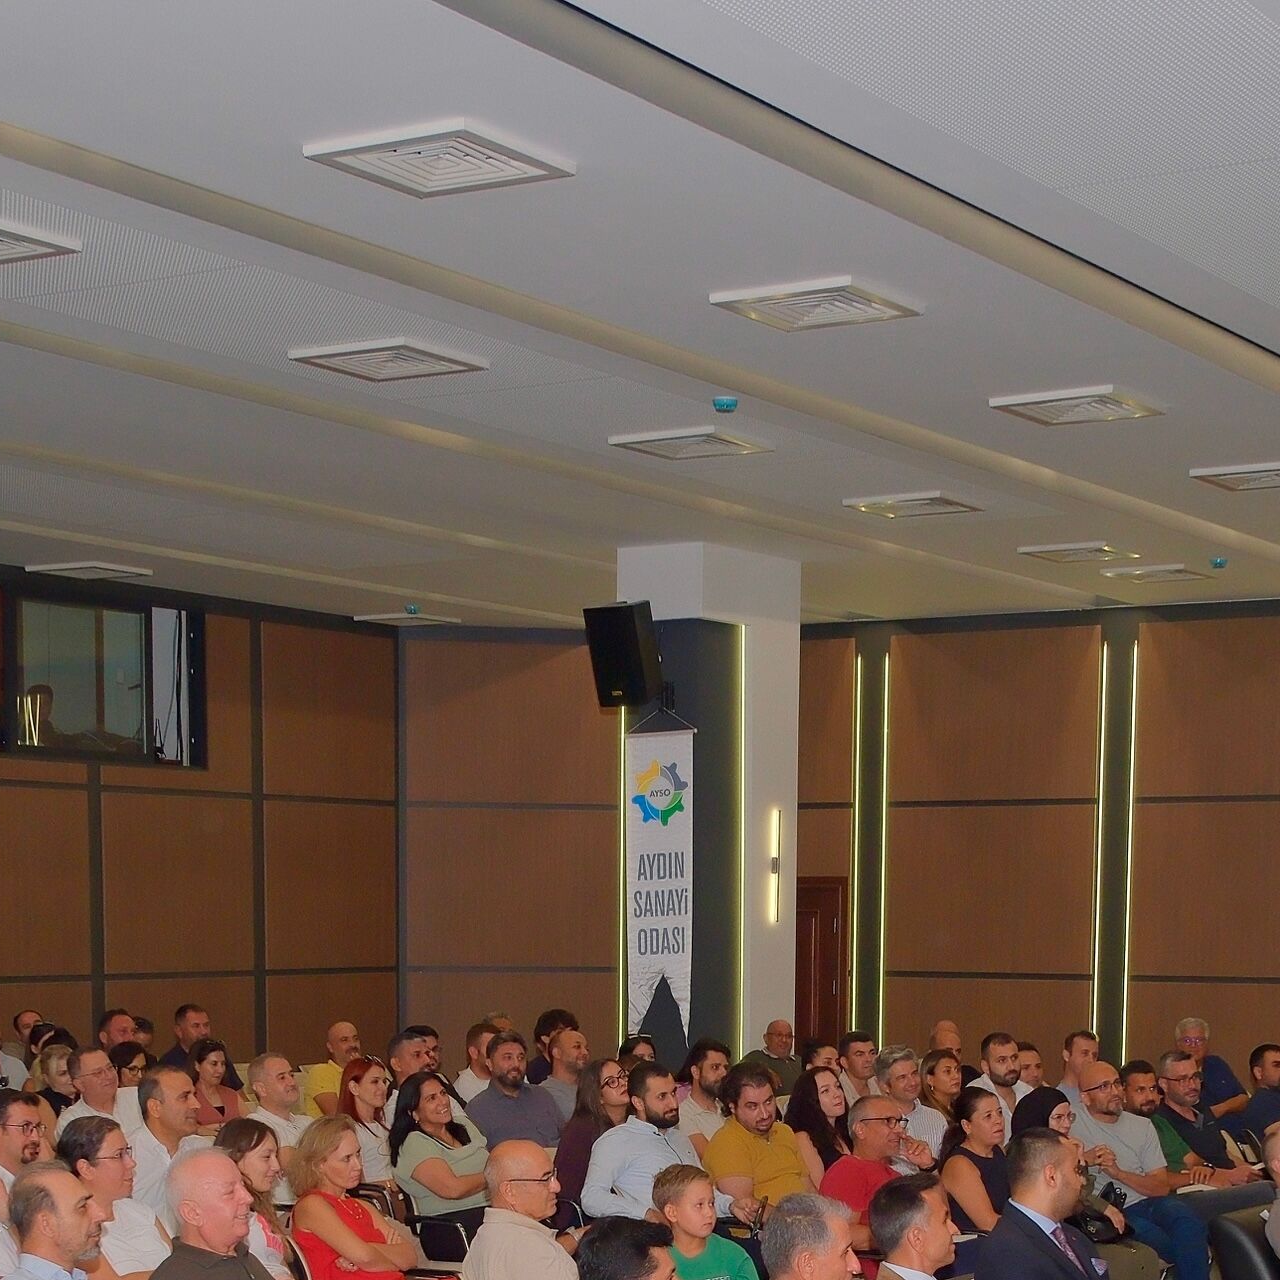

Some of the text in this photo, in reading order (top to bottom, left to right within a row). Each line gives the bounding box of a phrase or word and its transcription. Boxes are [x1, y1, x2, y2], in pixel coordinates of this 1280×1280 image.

[649, 788, 671, 798] AYSO
[637, 851, 685, 881] AYDIN
[637, 926, 685, 956] ODASI
